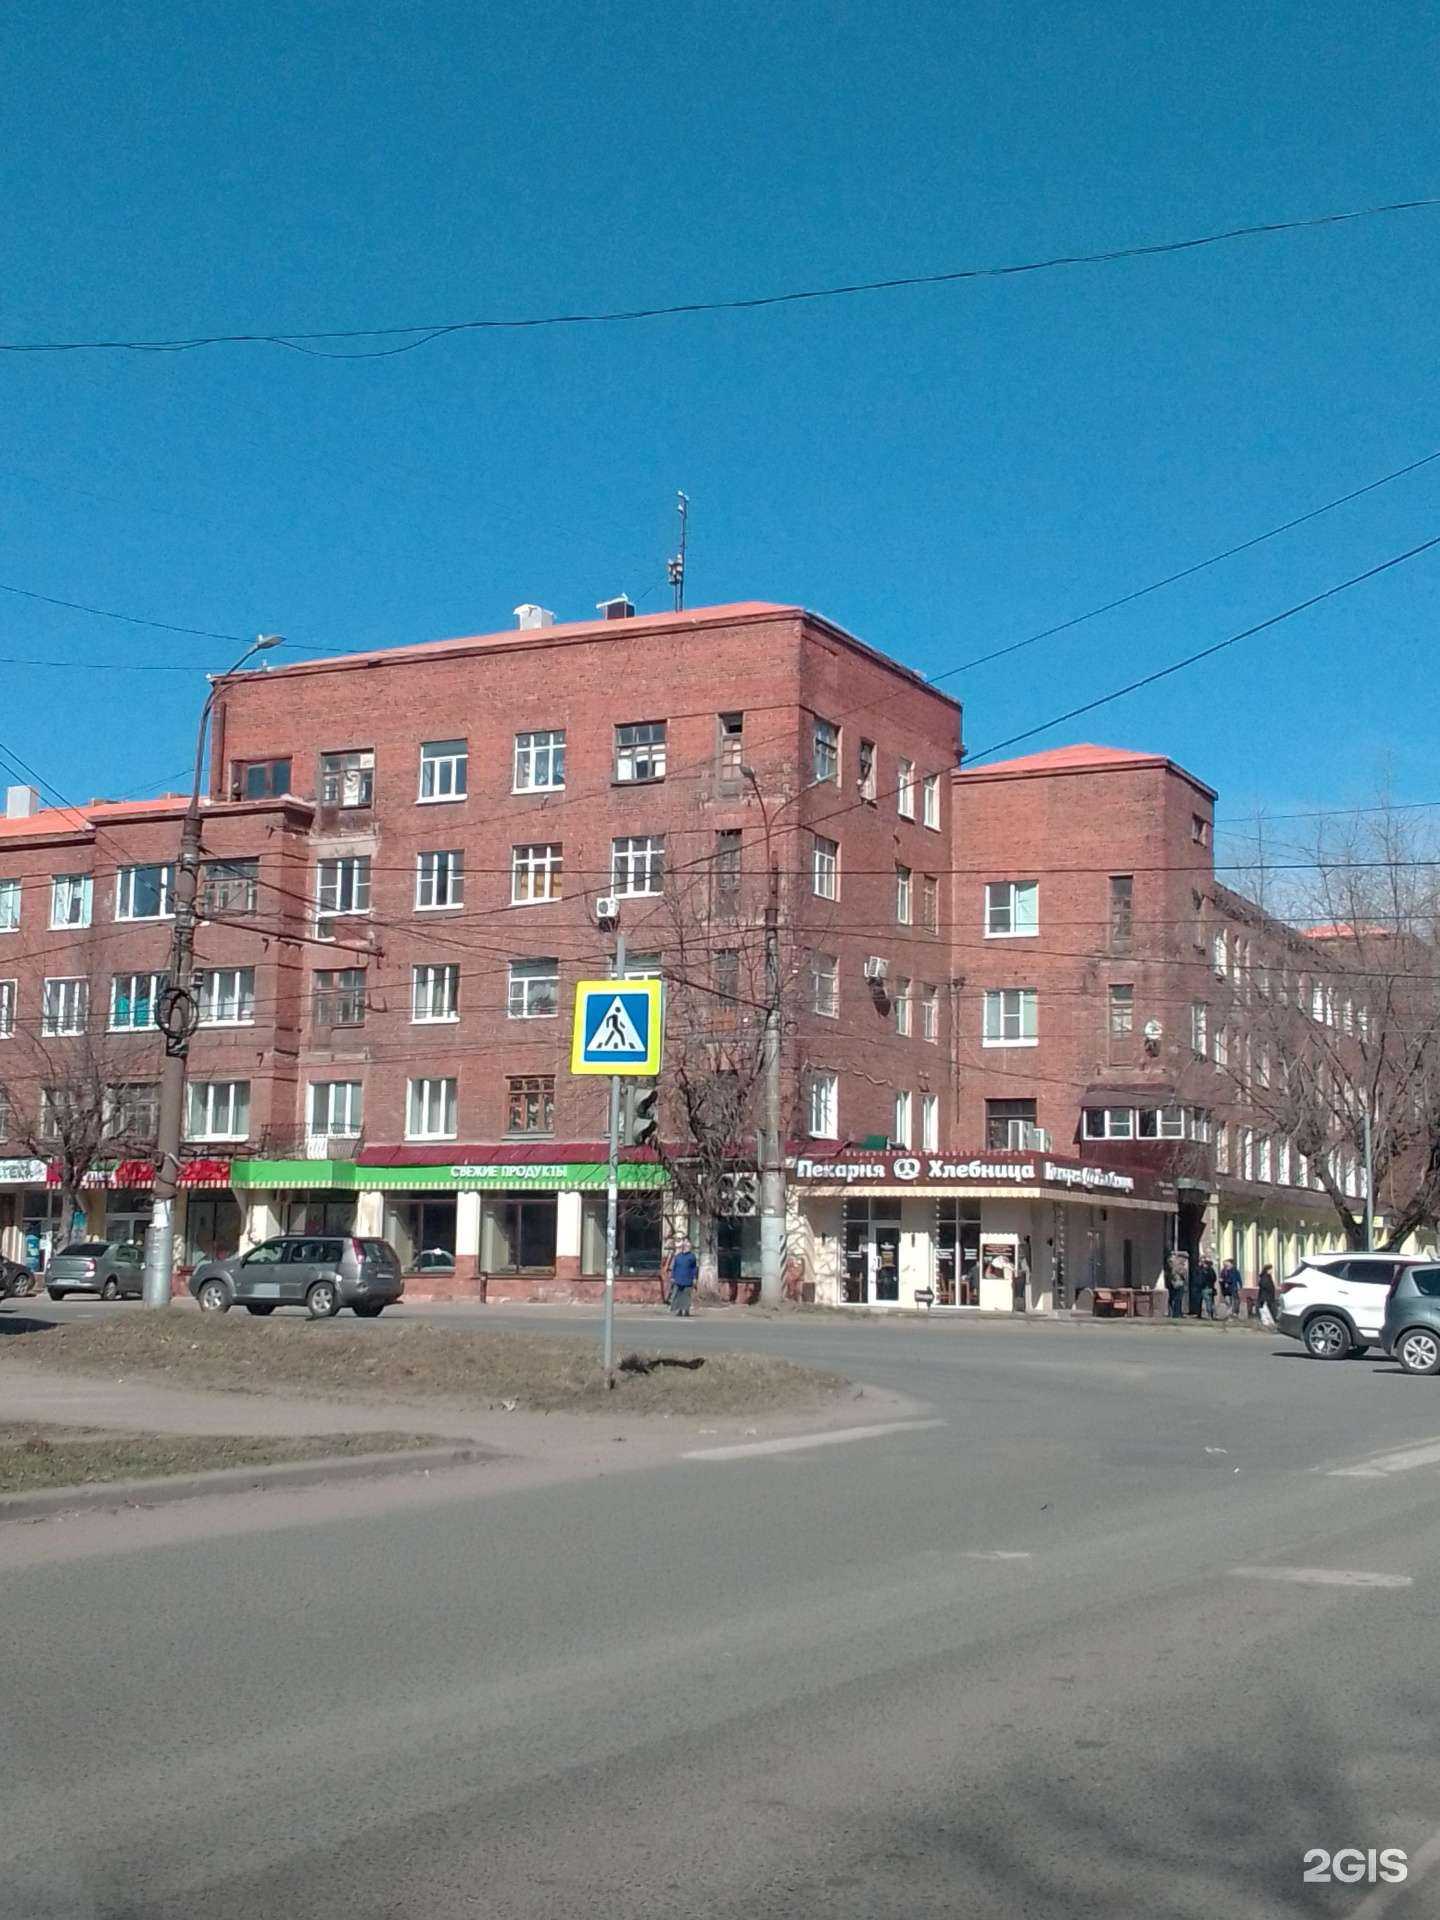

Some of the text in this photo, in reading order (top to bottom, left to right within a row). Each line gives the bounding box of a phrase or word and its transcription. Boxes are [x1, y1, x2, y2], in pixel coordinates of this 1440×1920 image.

[450, 1165, 568, 1179] СВЕЖИЕ ПРОДУКТЫ
[796, 1159, 886, 1183] Пекарня
[928, 1159, 1036, 1182] Хлебница
